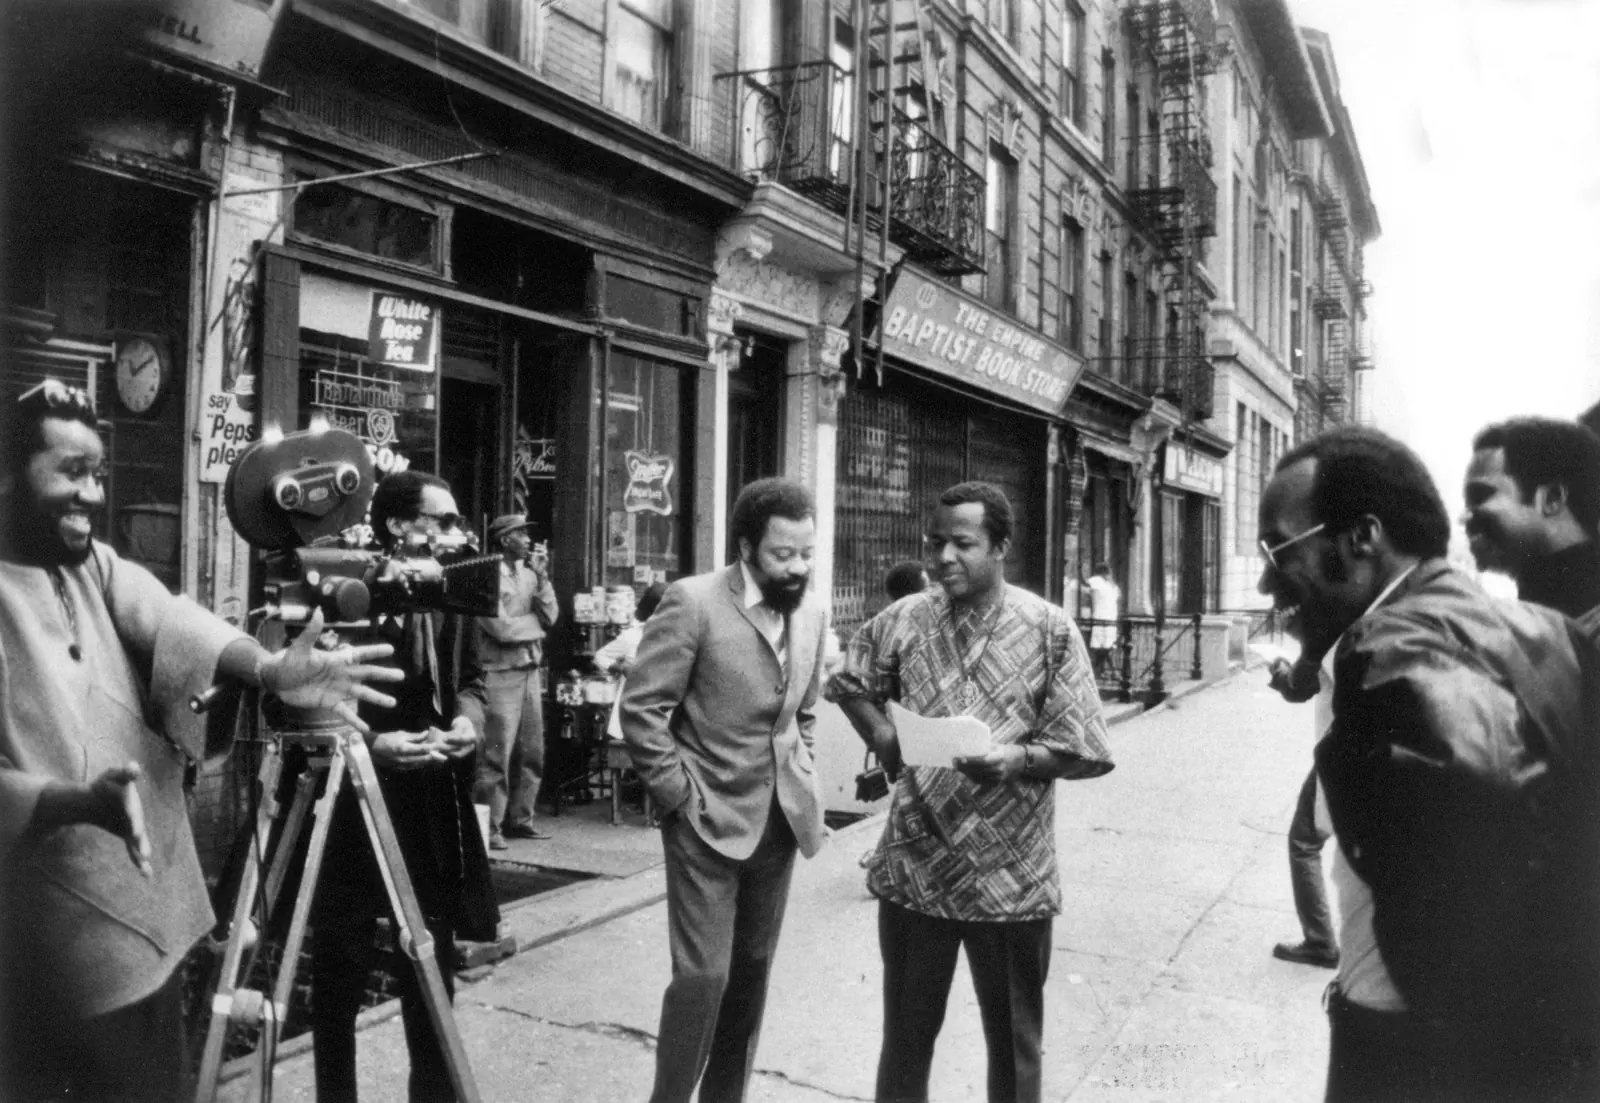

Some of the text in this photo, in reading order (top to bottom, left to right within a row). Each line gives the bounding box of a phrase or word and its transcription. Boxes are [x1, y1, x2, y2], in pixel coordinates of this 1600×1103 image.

[378, 296, 431, 321] White
[380, 318, 423, 340] Rose
[955, 302, 1046, 361] THE EMPIRE
[385, 340, 414, 361] Tea
[884, 305, 1067, 402] BAPTIST BOOK STORE
[208, 394, 232, 413] say
